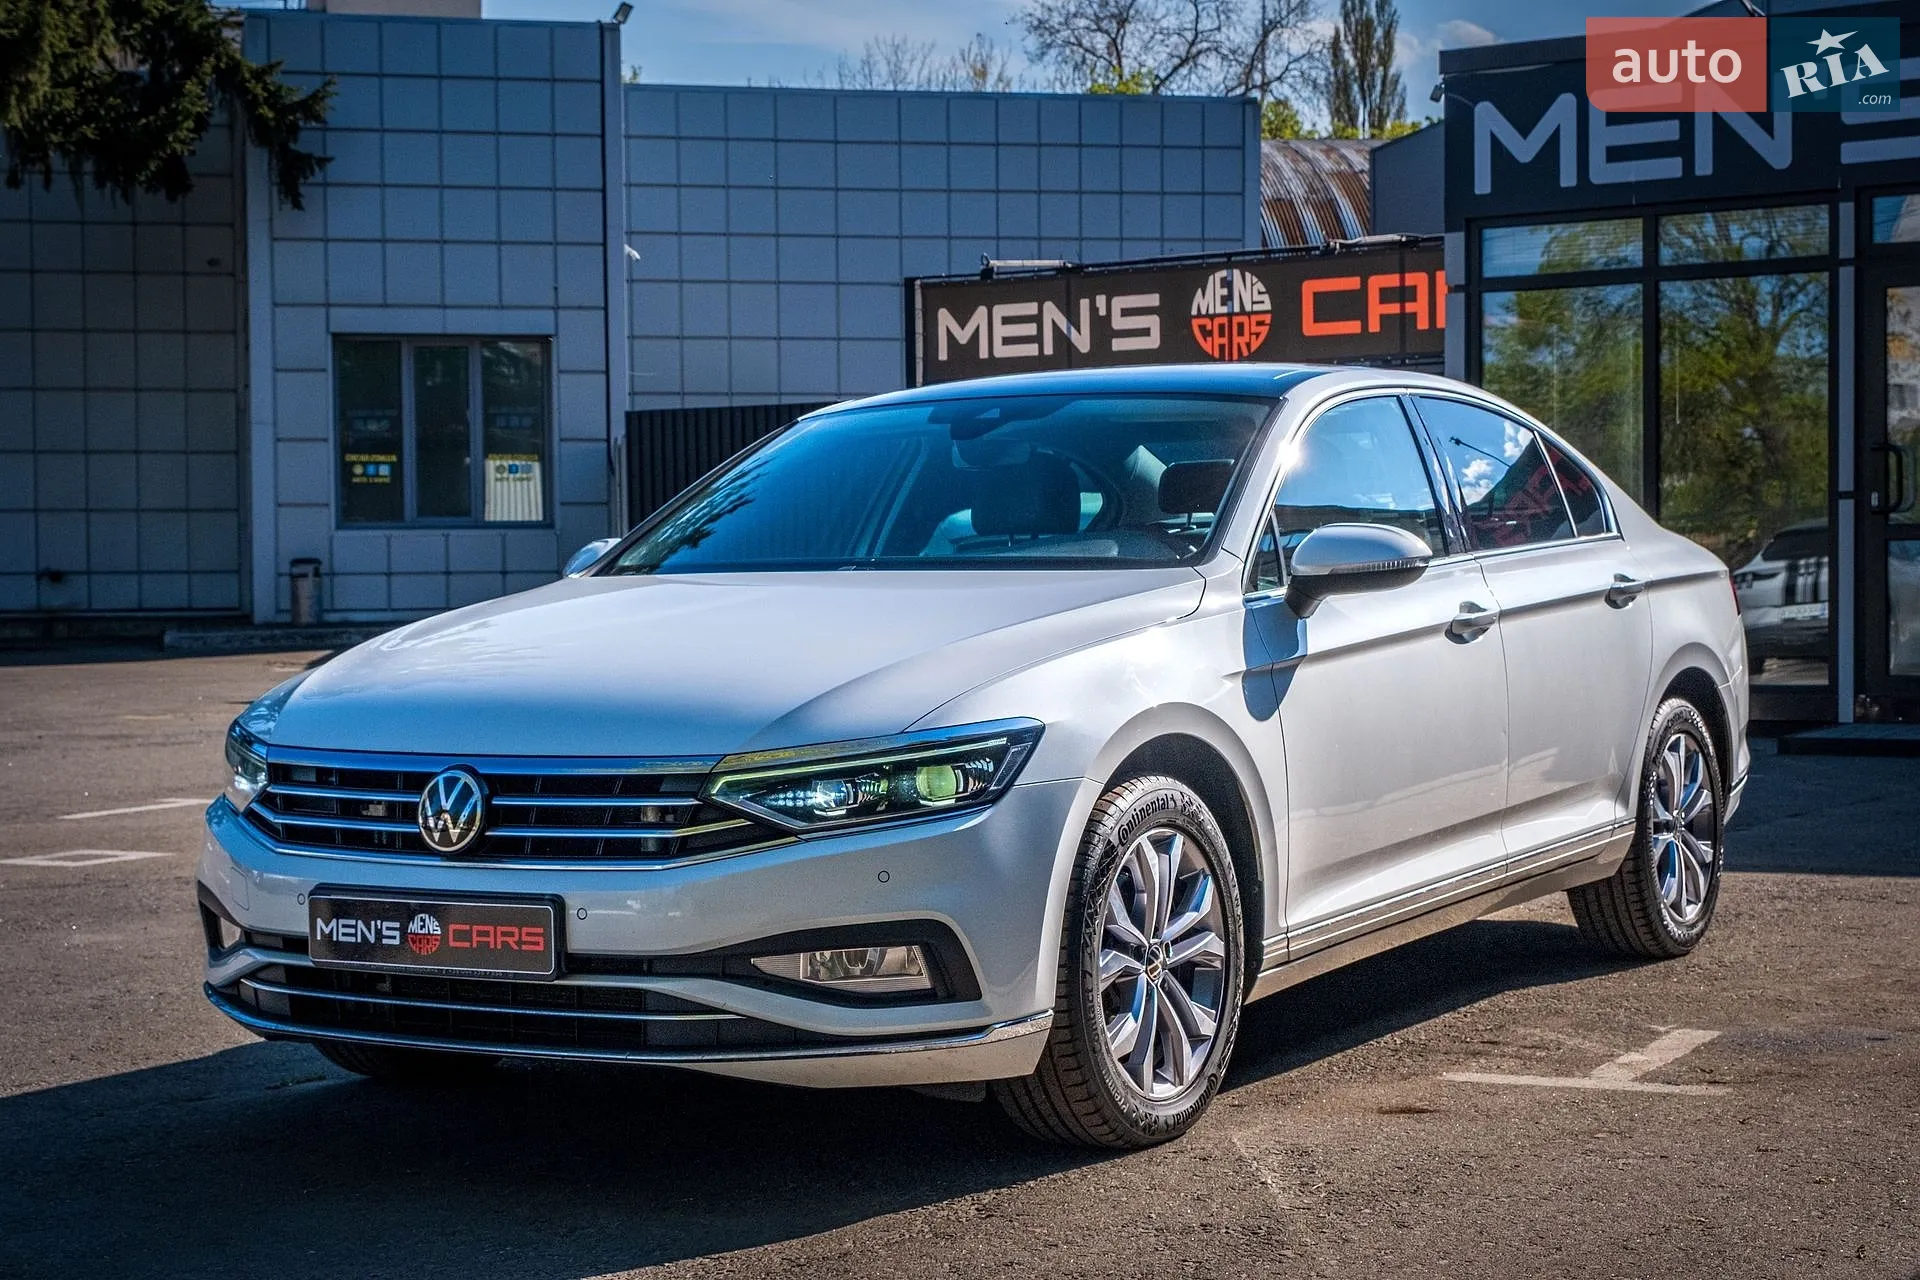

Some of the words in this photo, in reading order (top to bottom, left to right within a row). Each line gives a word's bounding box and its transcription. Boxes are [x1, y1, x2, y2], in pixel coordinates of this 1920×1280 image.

[1191, 268, 1272, 315] MEN'S
[937, 293, 1161, 361] MEN'S
[1191, 313, 1272, 361] CARS
[1117, 793, 1170, 847] Continental
[316, 917, 401, 946] MEN'S
[448, 924, 545, 951] CARS
[407, 913, 442, 935] MEN'S
[407, 934, 441, 955] CARS
